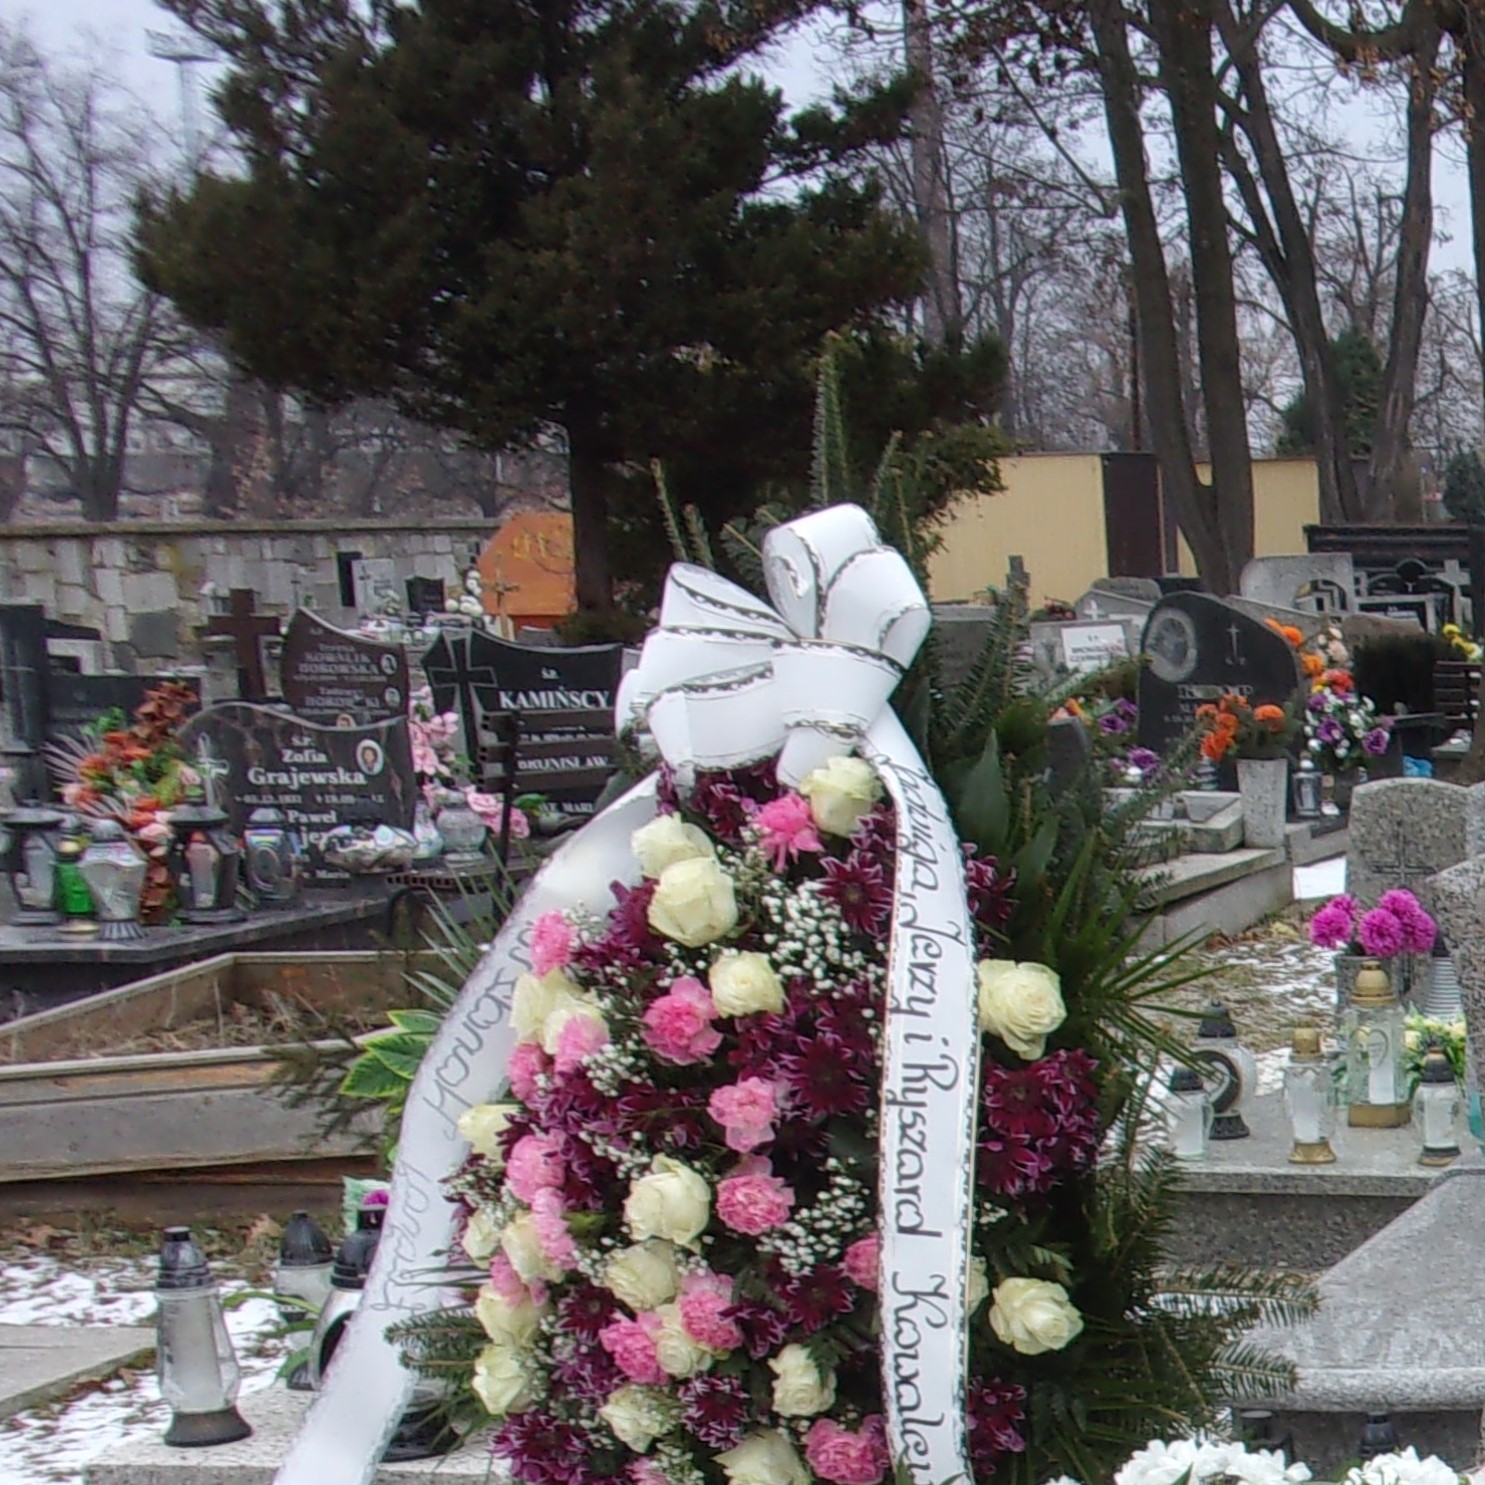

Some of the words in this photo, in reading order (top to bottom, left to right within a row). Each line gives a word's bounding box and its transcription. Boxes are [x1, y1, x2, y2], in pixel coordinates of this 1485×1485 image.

[500, 686, 610, 709] KAMIŃSCY
[282, 749, 328, 763] Zofia
[248, 766, 368, 788] Grajewska
[887, 910, 967, 1015] Jerzy
[904, 1036, 949, 1045] i
[884, 1054, 960, 1238] Ryszard
